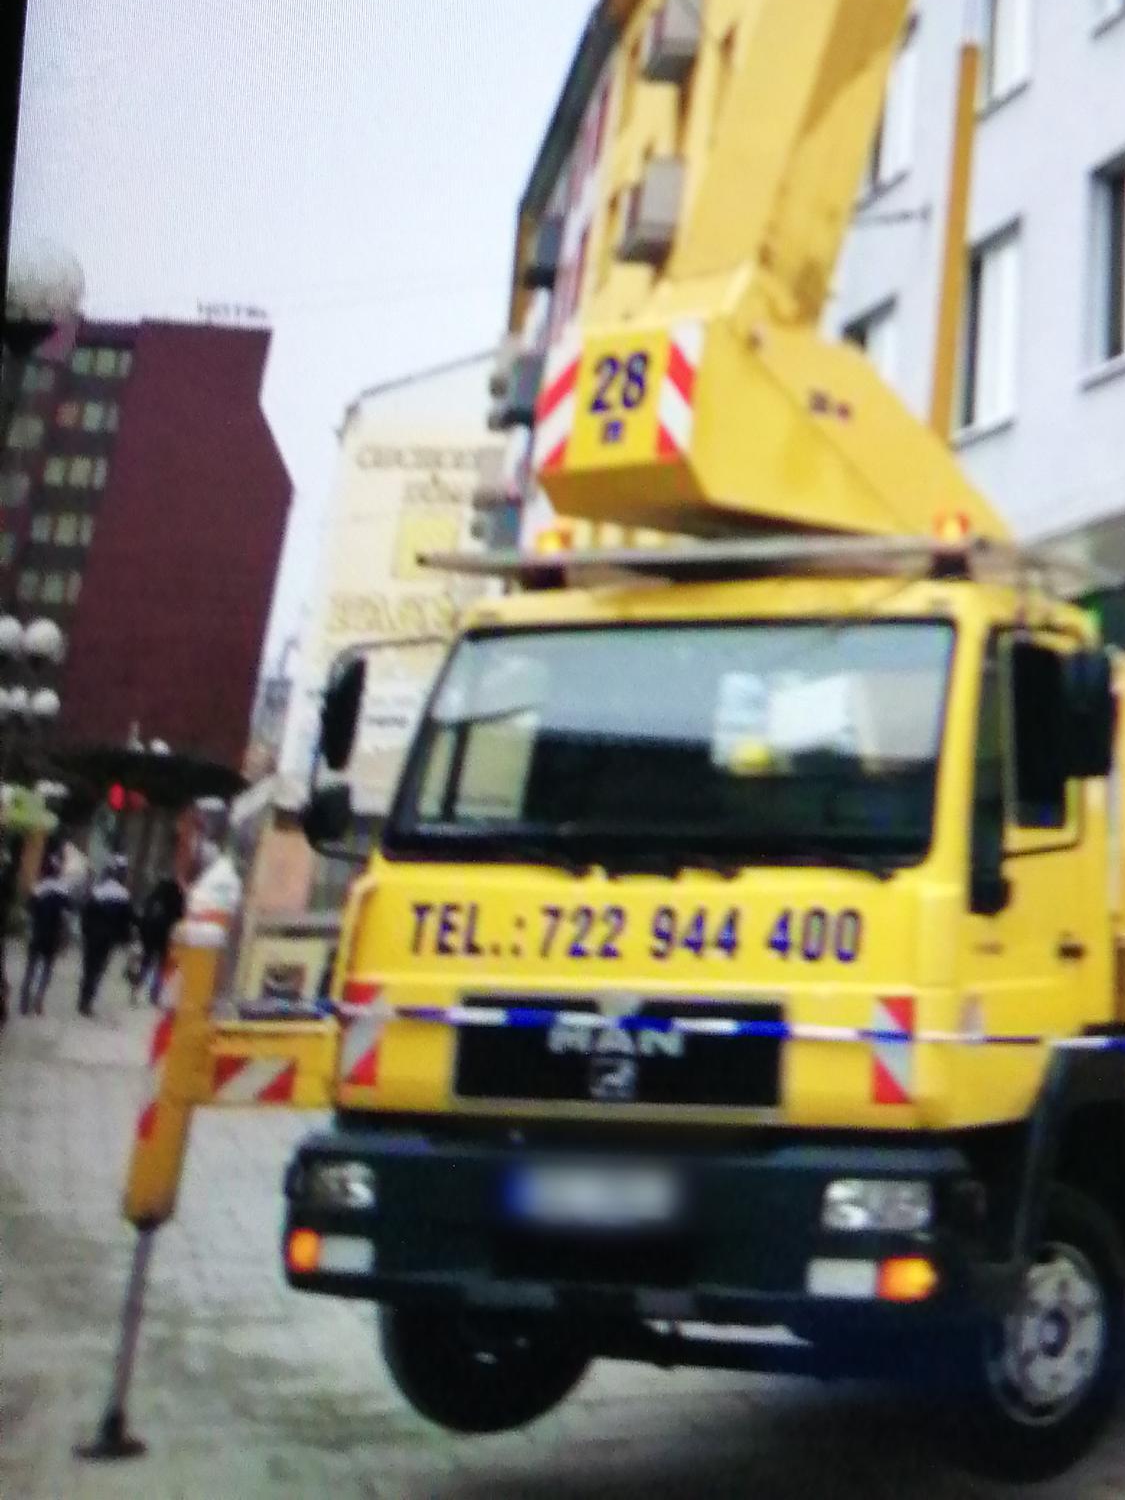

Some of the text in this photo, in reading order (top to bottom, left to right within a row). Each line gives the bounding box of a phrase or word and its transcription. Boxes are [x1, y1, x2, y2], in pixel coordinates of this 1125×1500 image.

[590, 351, 649, 412] 28
[540, 903, 628, 959] 722
[649, 904, 739, 961] 944
[766, 906, 864, 964] 400
